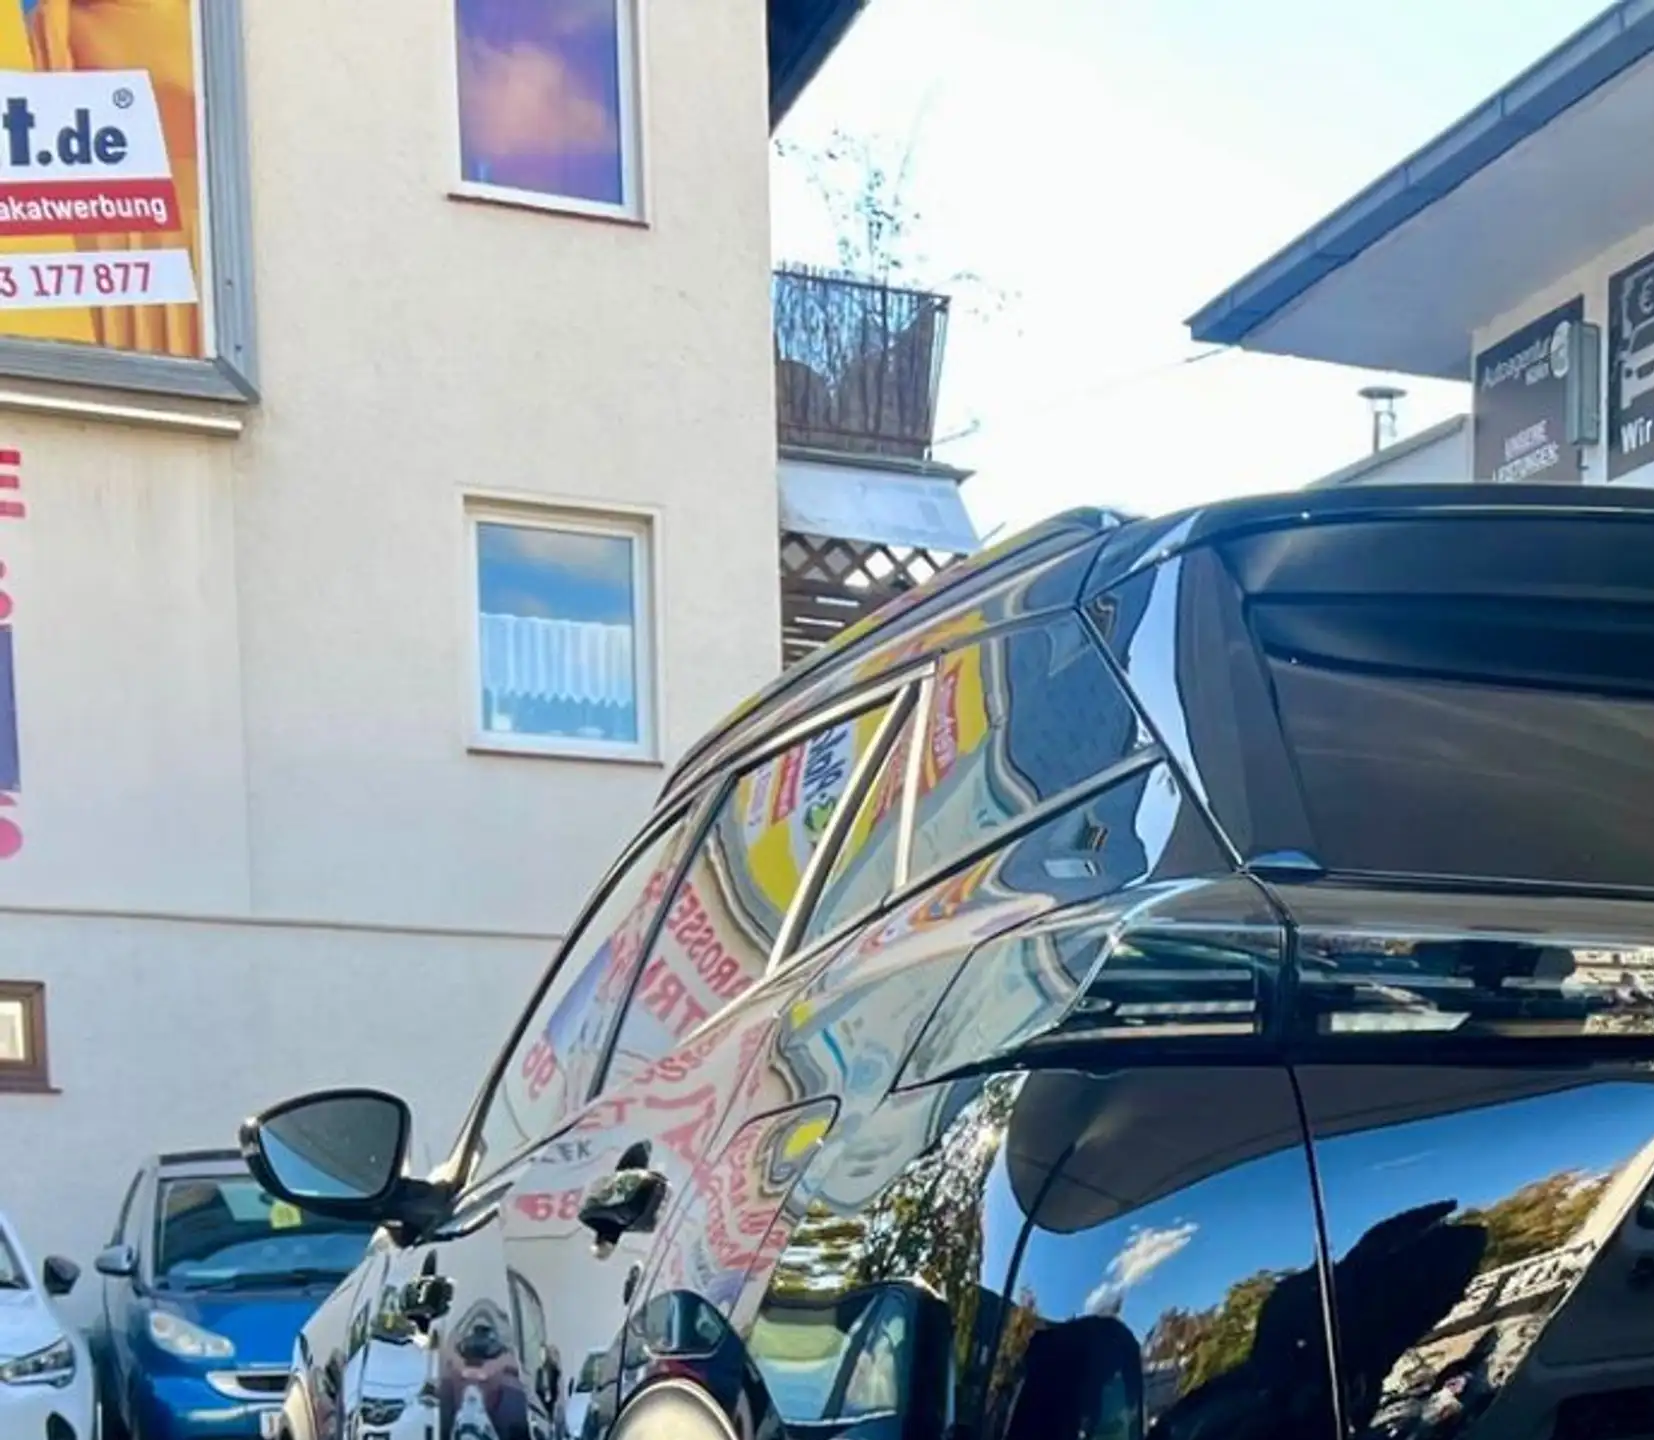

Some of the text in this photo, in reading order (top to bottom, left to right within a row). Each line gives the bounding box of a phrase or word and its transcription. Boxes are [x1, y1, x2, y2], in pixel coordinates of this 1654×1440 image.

[30, 264, 84, 296] 177
[94, 261, 150, 293] 877
[1620, 419, 1654, 455] Wir
